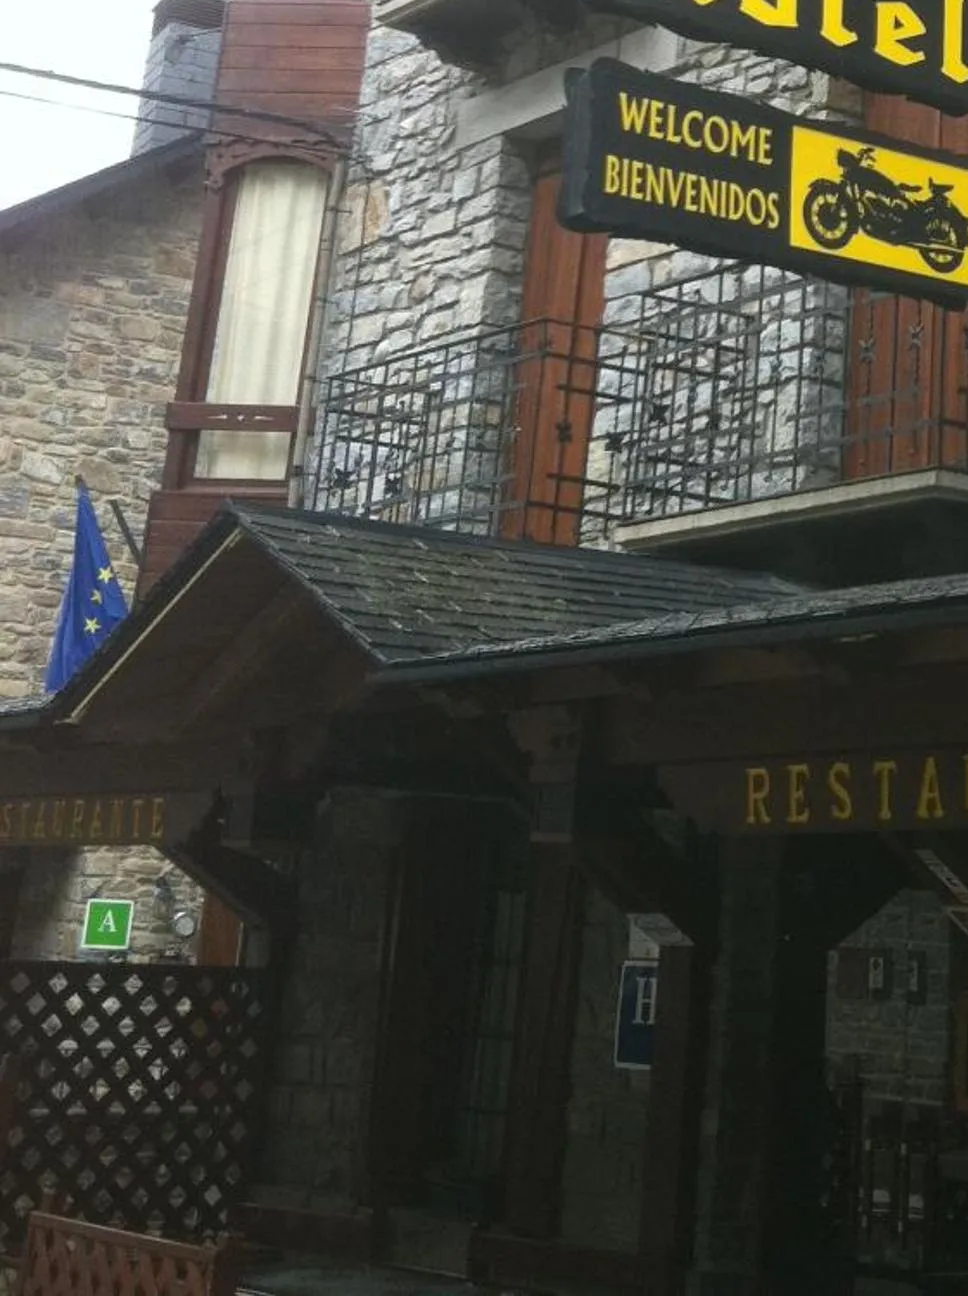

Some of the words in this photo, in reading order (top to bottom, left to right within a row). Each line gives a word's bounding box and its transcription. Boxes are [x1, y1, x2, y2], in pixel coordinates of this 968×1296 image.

[618, 91, 774, 166] WELCOME
[604, 154, 781, 230] BIENVENIDOS
[97, 909, 118, 933] A
